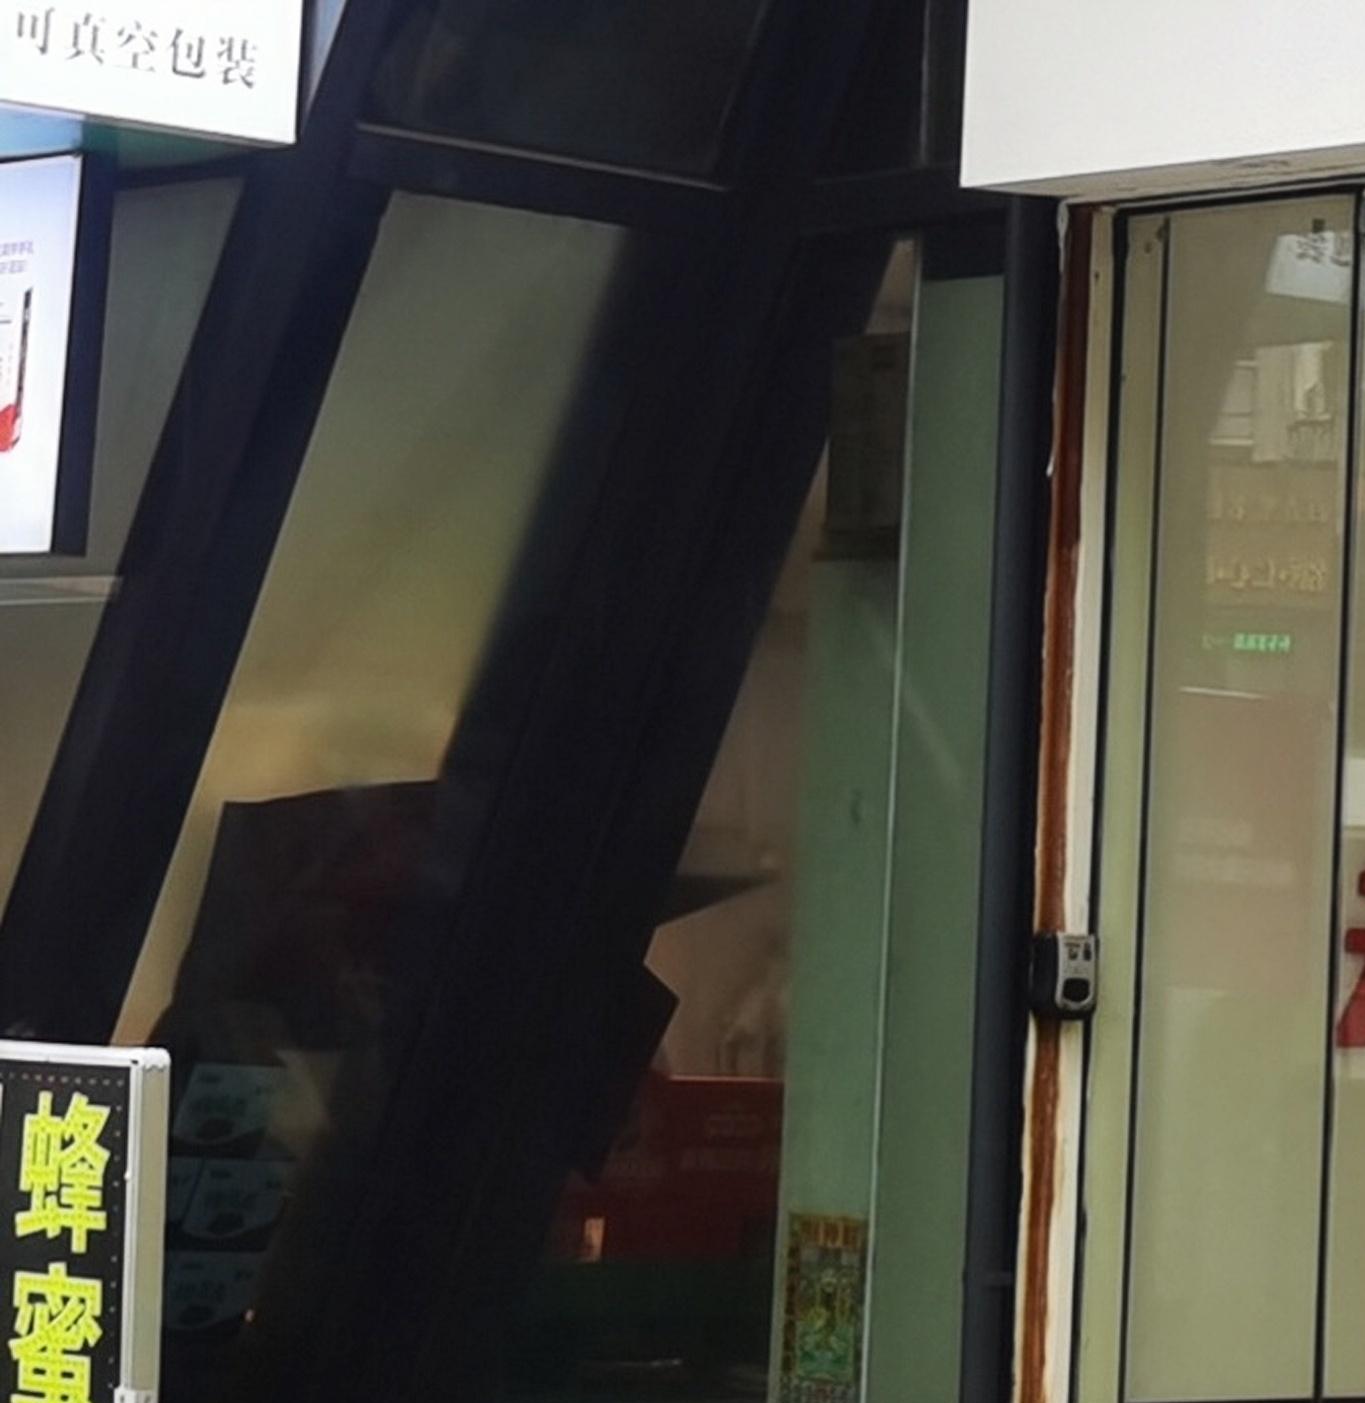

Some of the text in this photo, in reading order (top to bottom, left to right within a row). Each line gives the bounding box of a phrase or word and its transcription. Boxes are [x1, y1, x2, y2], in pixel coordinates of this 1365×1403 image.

[15, 6, 257, 90] 可真空包装
